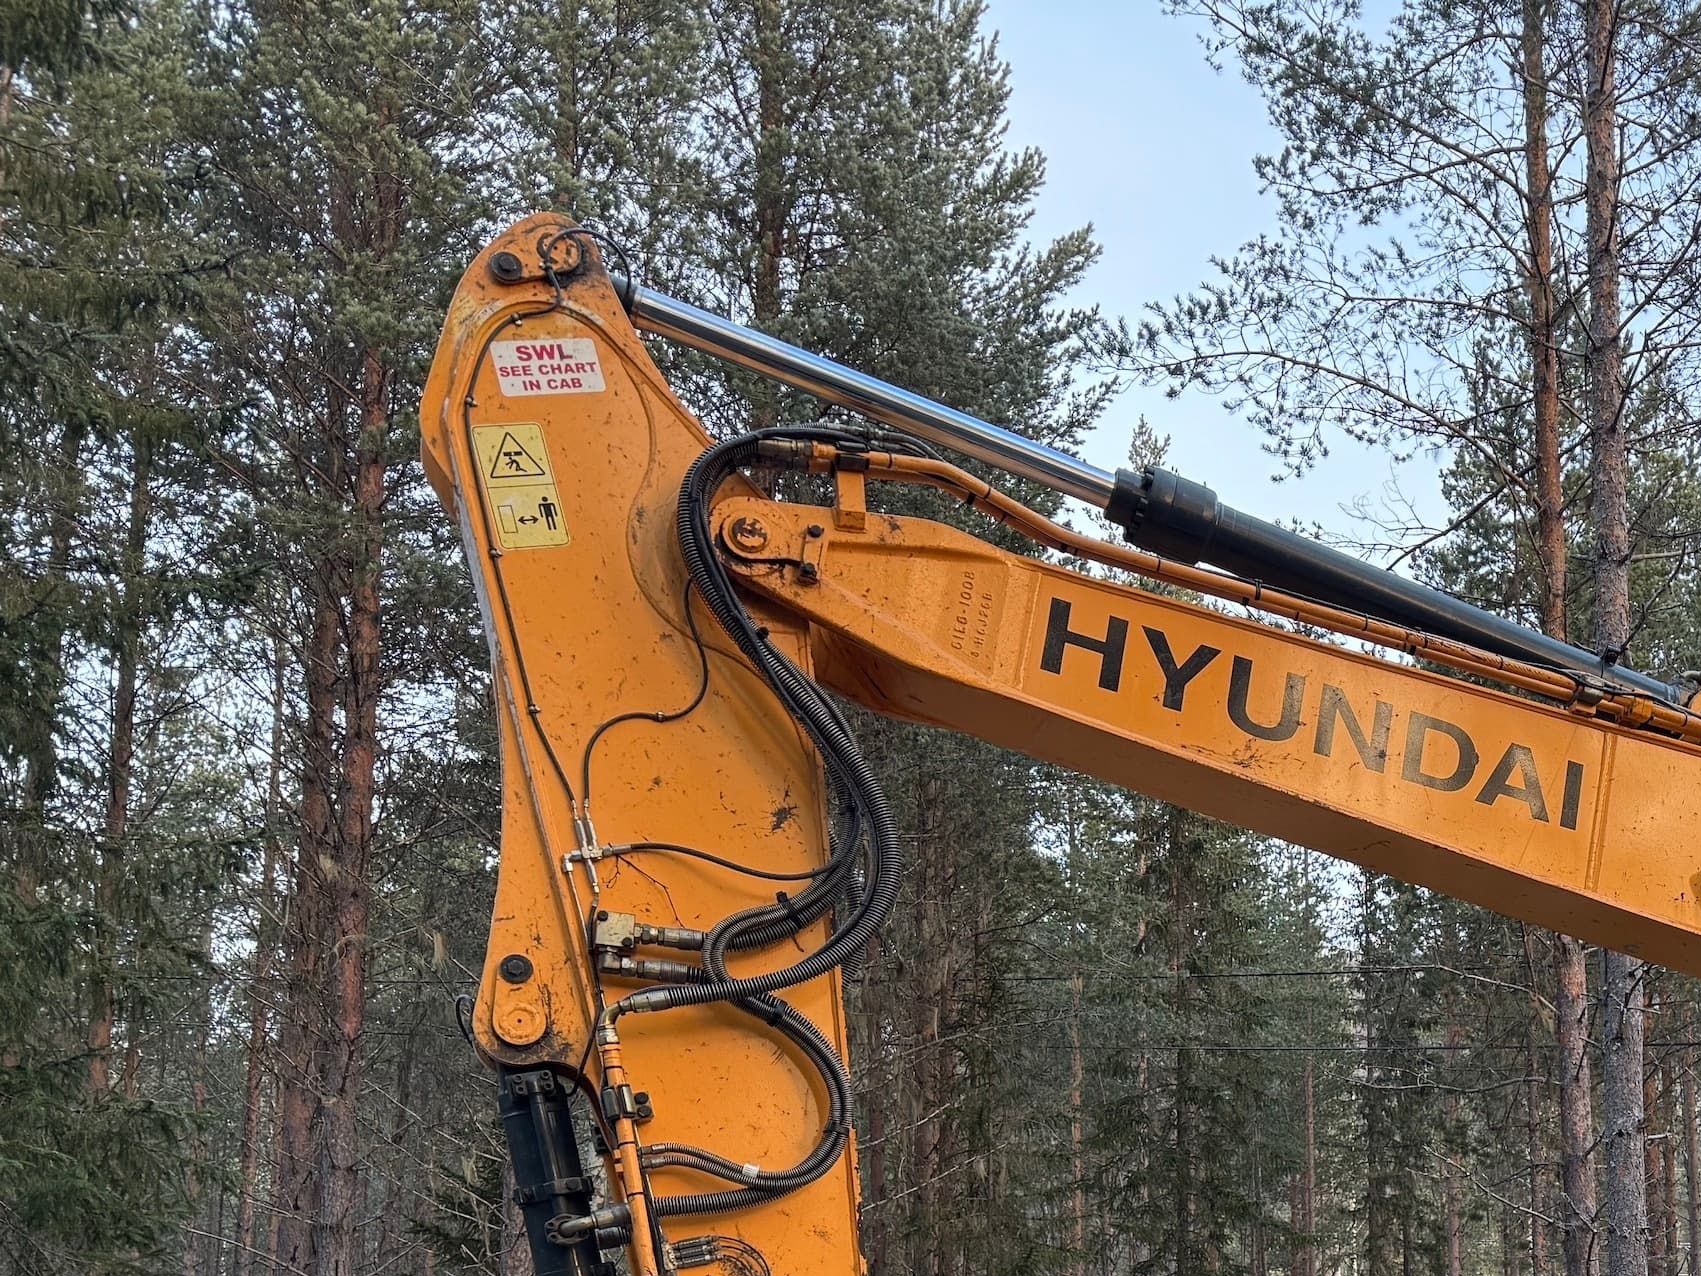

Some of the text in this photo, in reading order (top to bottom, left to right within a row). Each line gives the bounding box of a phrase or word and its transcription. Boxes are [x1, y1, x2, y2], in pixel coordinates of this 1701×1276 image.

[515, 344, 573, 361] SWL
[499, 361, 597, 378] SEE CHART
[522, 377, 583, 391] IN CAB
[1039, 597, 1584, 831] HYUNDAI
